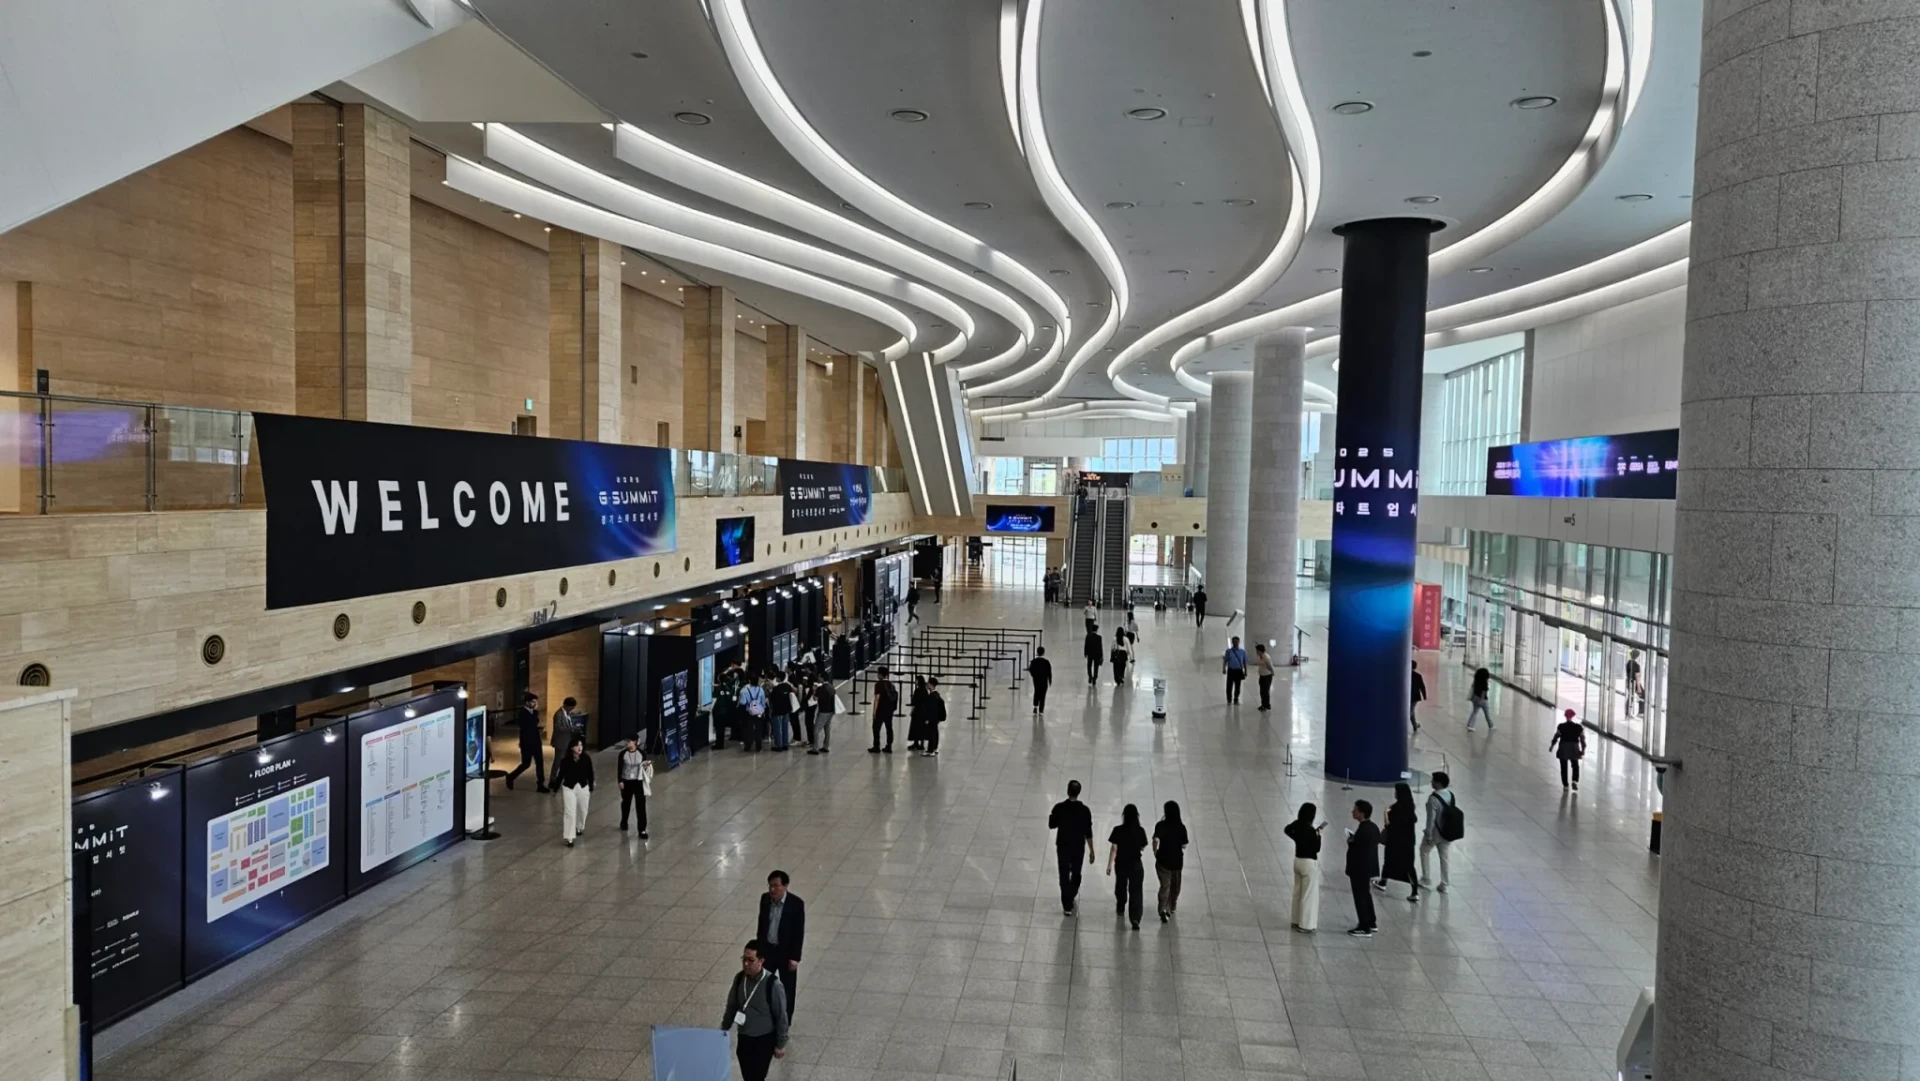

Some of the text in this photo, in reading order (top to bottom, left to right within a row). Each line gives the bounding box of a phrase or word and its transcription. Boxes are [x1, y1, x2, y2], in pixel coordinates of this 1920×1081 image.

[311, 479, 570, 535] WELCOME
[548, 600, 557, 623] 2
[254, 759, 291, 779] FLOOR PLAN
